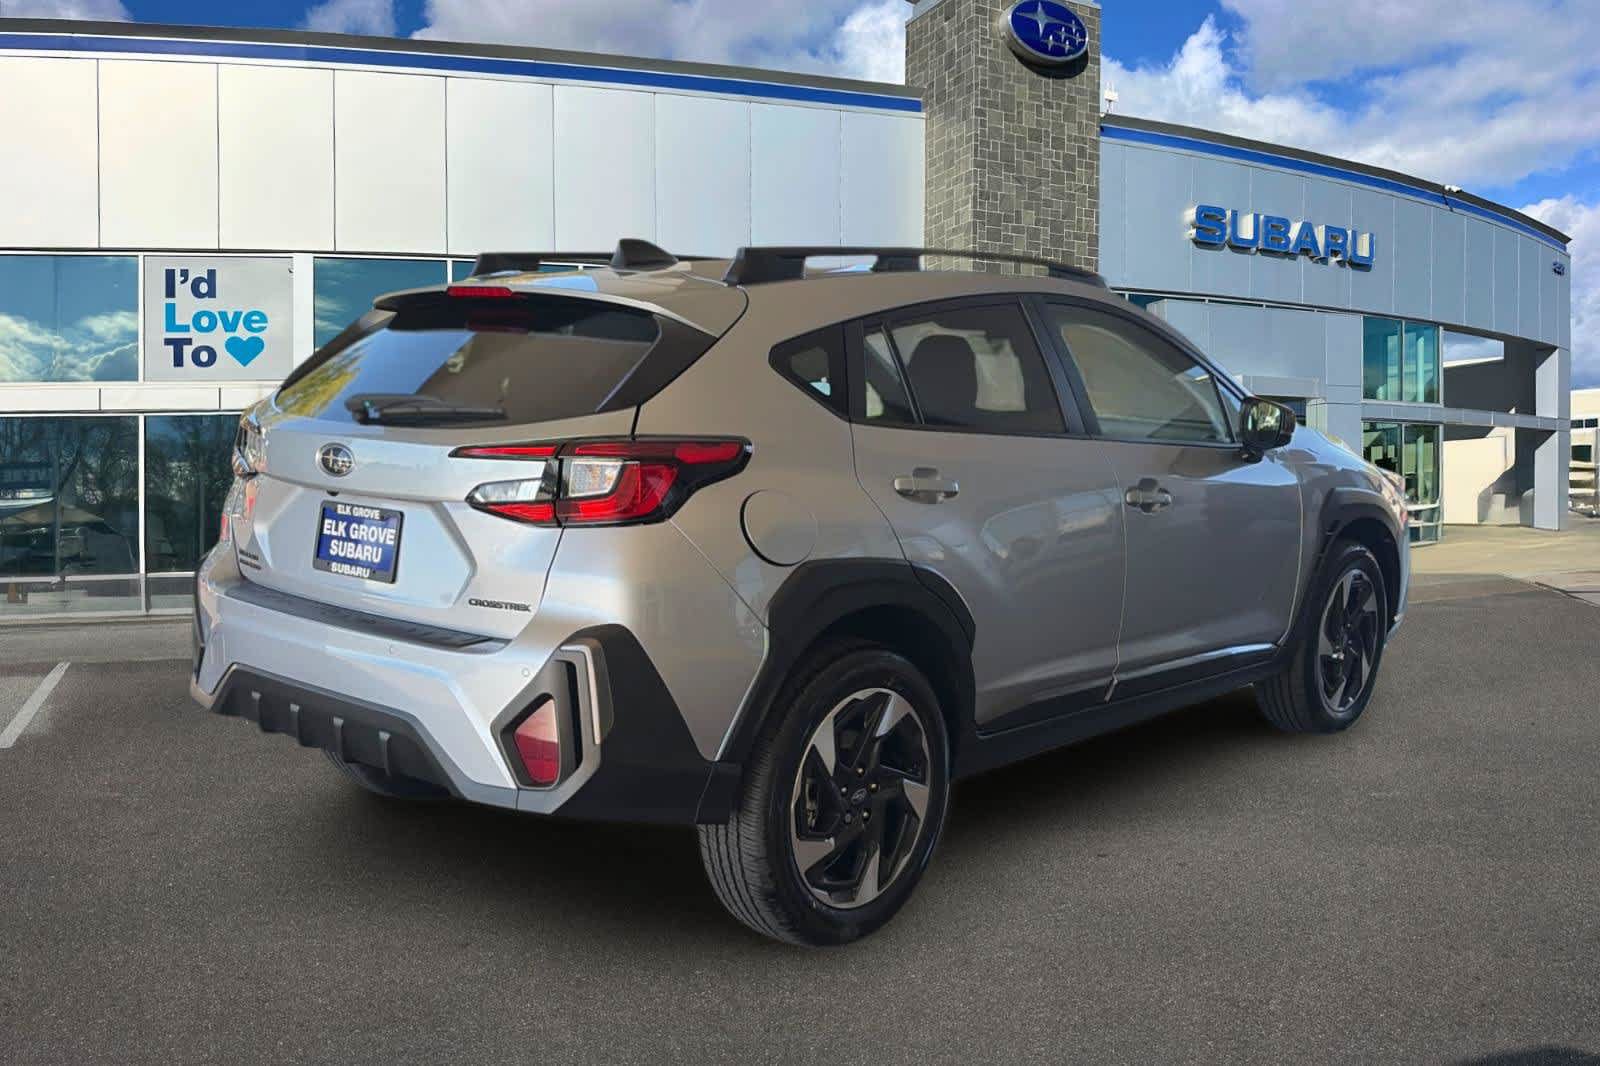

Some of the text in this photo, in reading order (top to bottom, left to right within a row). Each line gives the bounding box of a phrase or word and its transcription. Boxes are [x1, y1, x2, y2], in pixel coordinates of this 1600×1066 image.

[1191, 204, 1376, 270] SUBARU
[165, 269, 217, 299] I'd
[165, 303, 269, 333] Love
[164, 337, 218, 368] To
[336, 503, 381, 520] ELK GROVE
[323, 518, 396, 545] ELK GROVE
[329, 539, 383, 563] SUBARU
[331, 562, 371, 578] SUBARU
[468, 598, 531, 612] CROSSTREK
